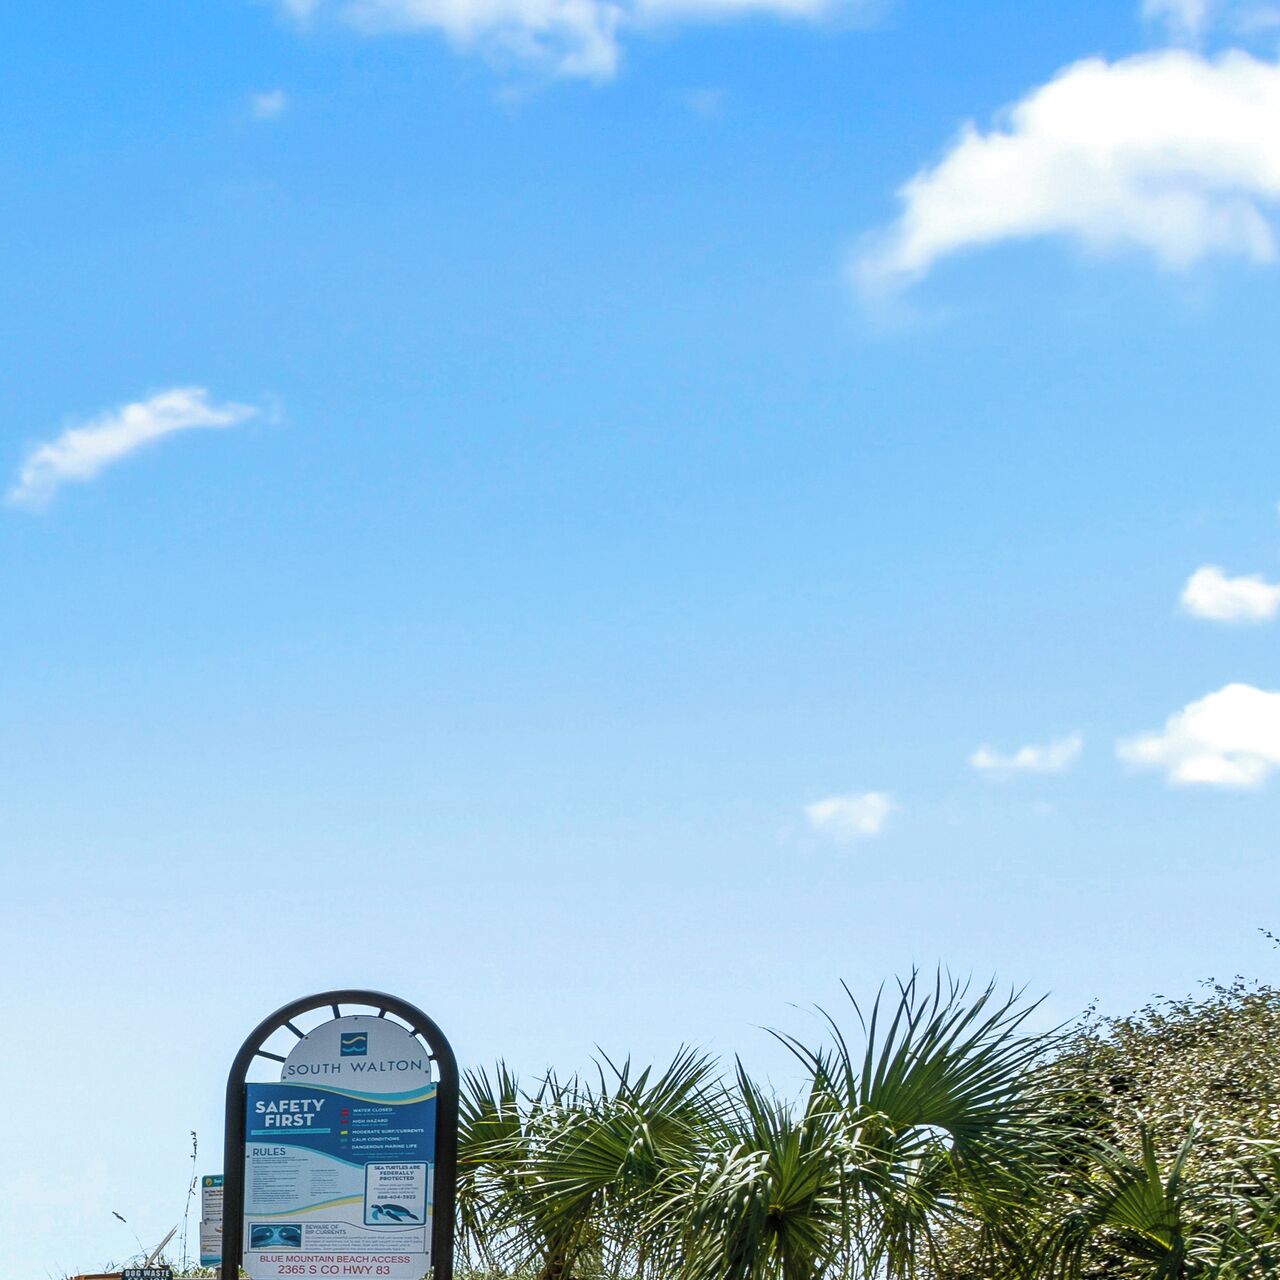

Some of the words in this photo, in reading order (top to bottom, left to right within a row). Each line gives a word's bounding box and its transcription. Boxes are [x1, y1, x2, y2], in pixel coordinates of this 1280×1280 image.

[288, 1063, 340, 1076] SOUTH
[350, 1060, 422, 1072] WALTON
[255, 1099, 325, 1113] SAFETY
[264, 1113, 314, 1127] FIRST
[252, 1148, 286, 1156] RULES
[260, 1255, 284, 1263] BLUE
[285, 1255, 336, 1263] MOUNTAIN
[338, 1255, 368, 1263] BEACH
[370, 1256, 410, 1264] ACCESS
[278, 1265, 305, 1274] 2365
[308, 1265, 317, 1274] S
[320, 1265, 340, 1274] CO
[344, 1265, 372, 1274] HWY
[375, 1265, 390, 1275] 83
